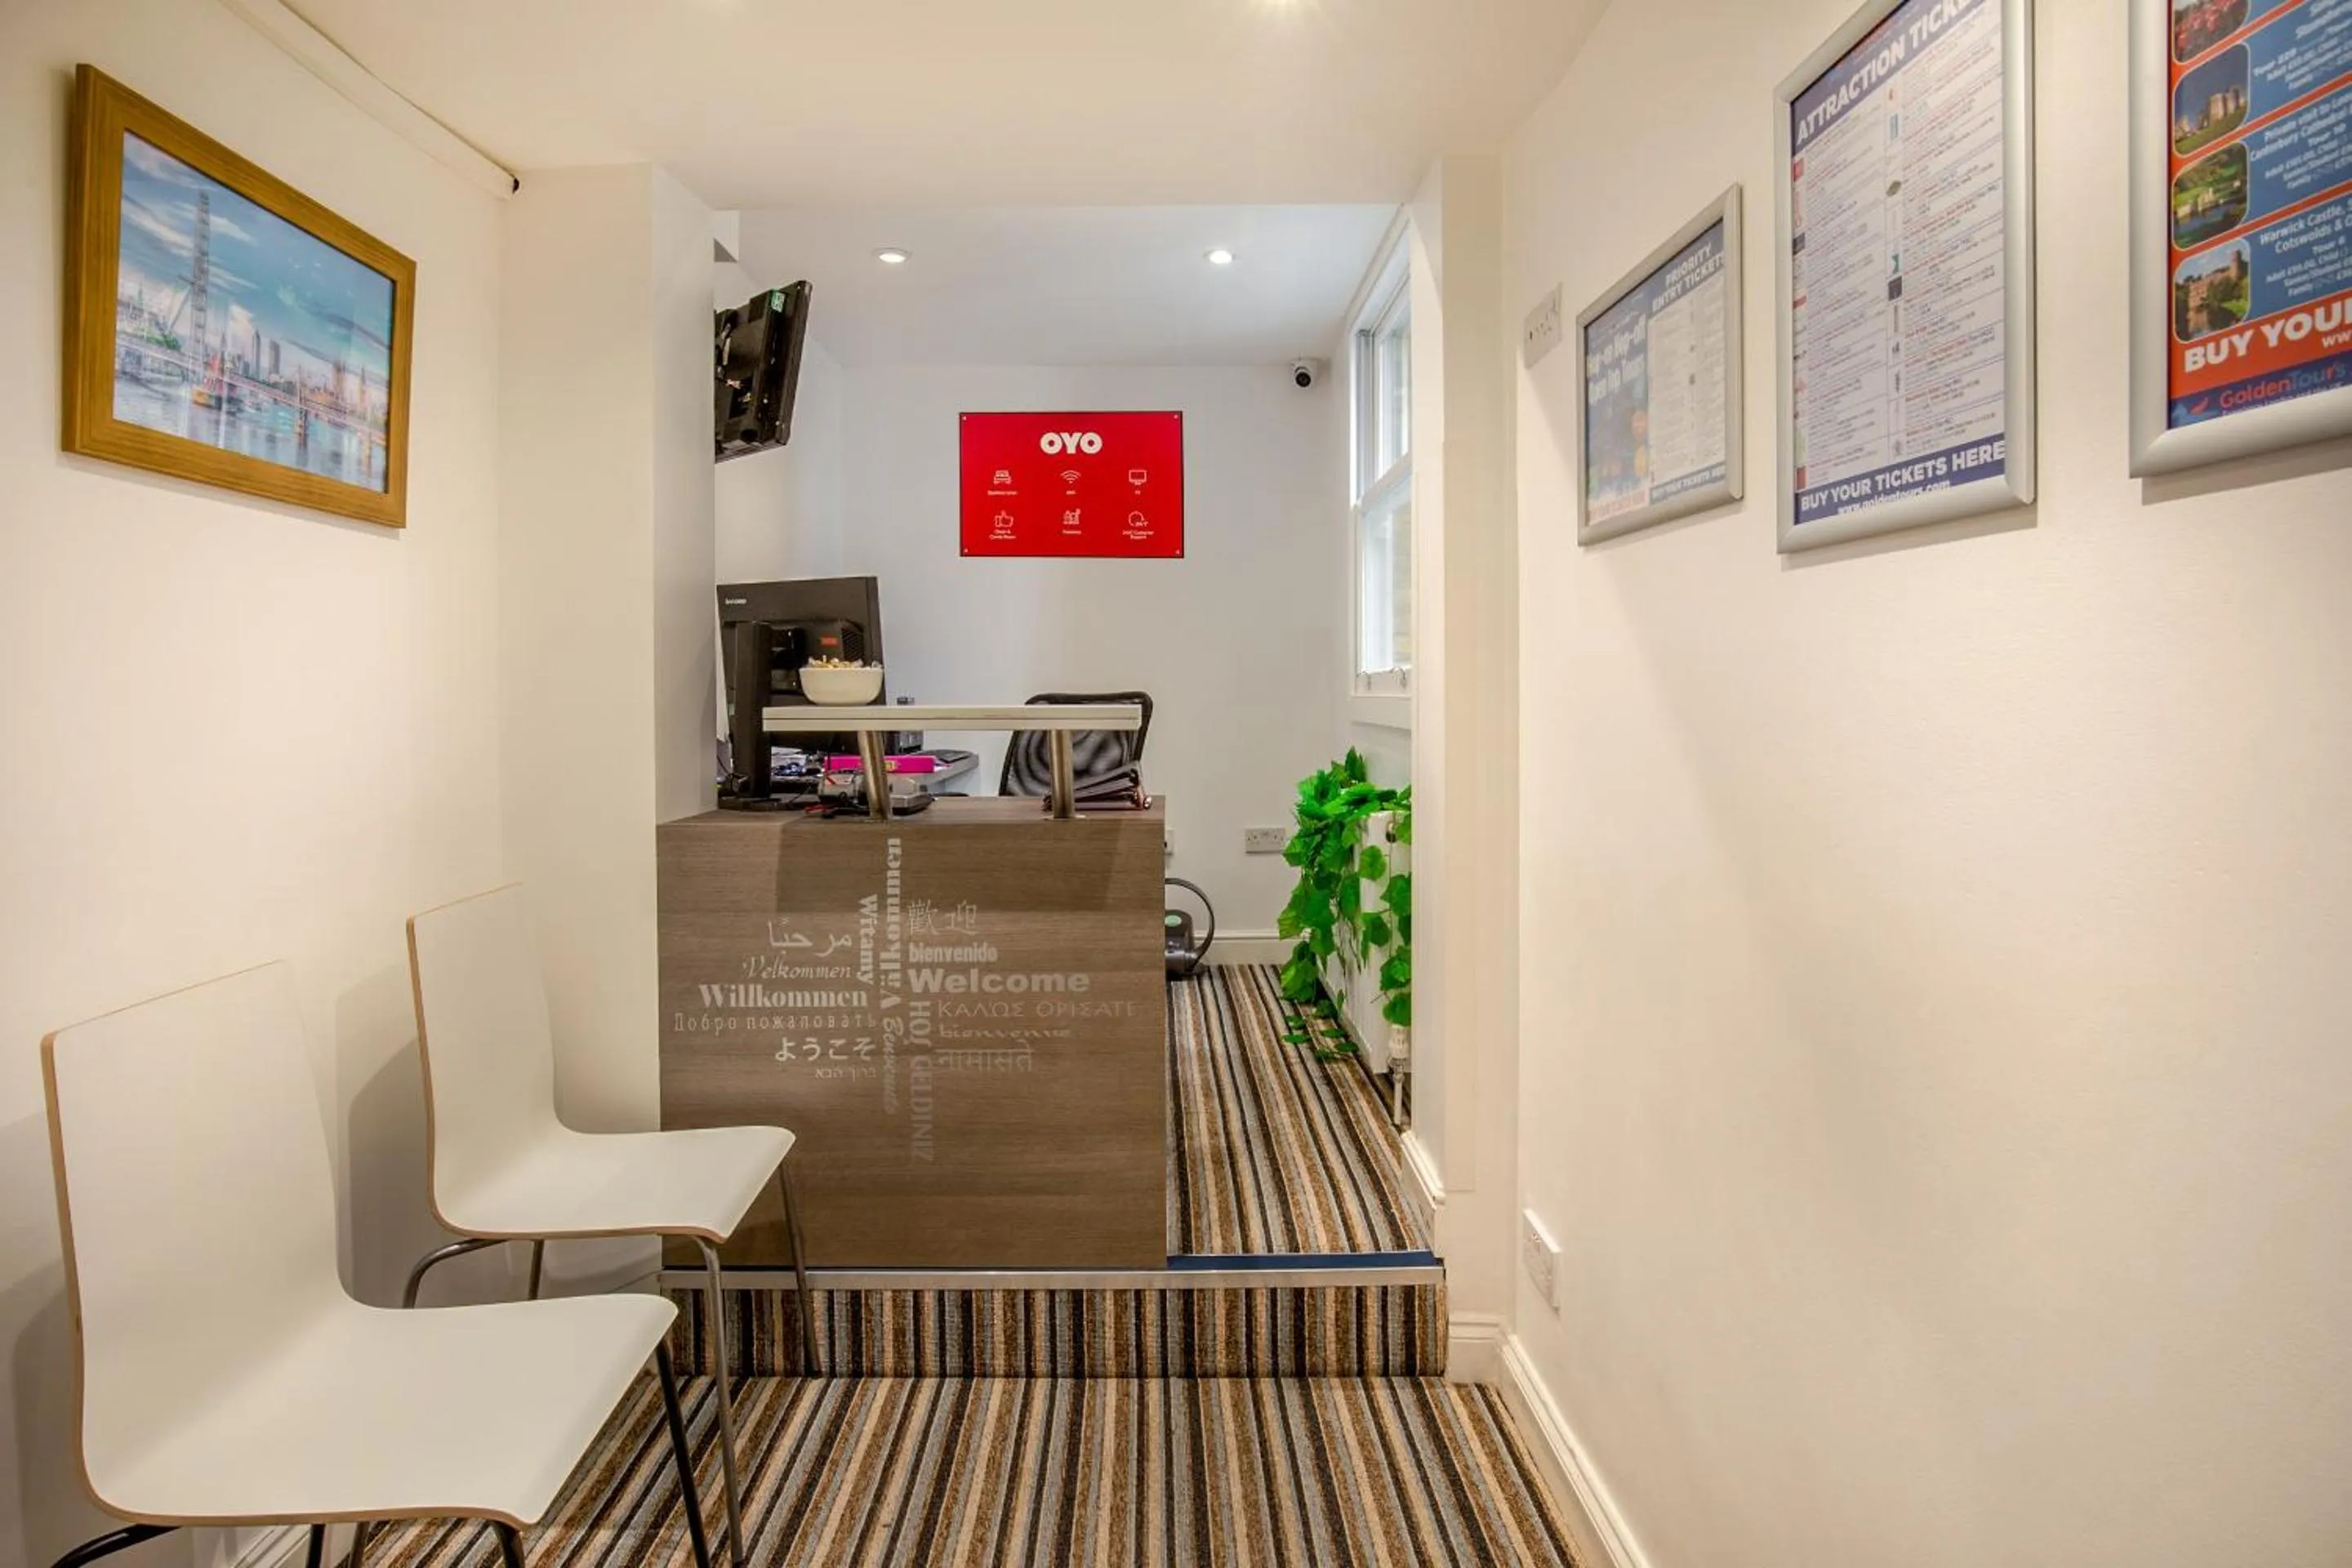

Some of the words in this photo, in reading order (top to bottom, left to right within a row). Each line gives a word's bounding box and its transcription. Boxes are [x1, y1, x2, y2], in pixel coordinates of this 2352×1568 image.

[1797, 34, 1905, 145] ATTRACTION
[1665, 242, 1712, 287] PRIORITY
[1652, 281, 1682, 313] ENTRY
[2185, 329, 2255, 373] BUY
[1040, 432, 1102, 454] OYO
[1801, 490, 1829, 512] BUY
[1829, 478, 1872, 503] YOUR
[1875, 457, 1947, 490] TICKETS
[1952, 440, 2005, 471] HERE
[907, 898, 978, 936] 歡迎
[742, 954, 851, 979] Velkommen
[908, 942, 998, 963] bienvenido
[698, 983, 868, 1008] Willkommen
[907, 968, 1090, 994] Welcome
[775, 1036, 876, 1062] ようこそ
